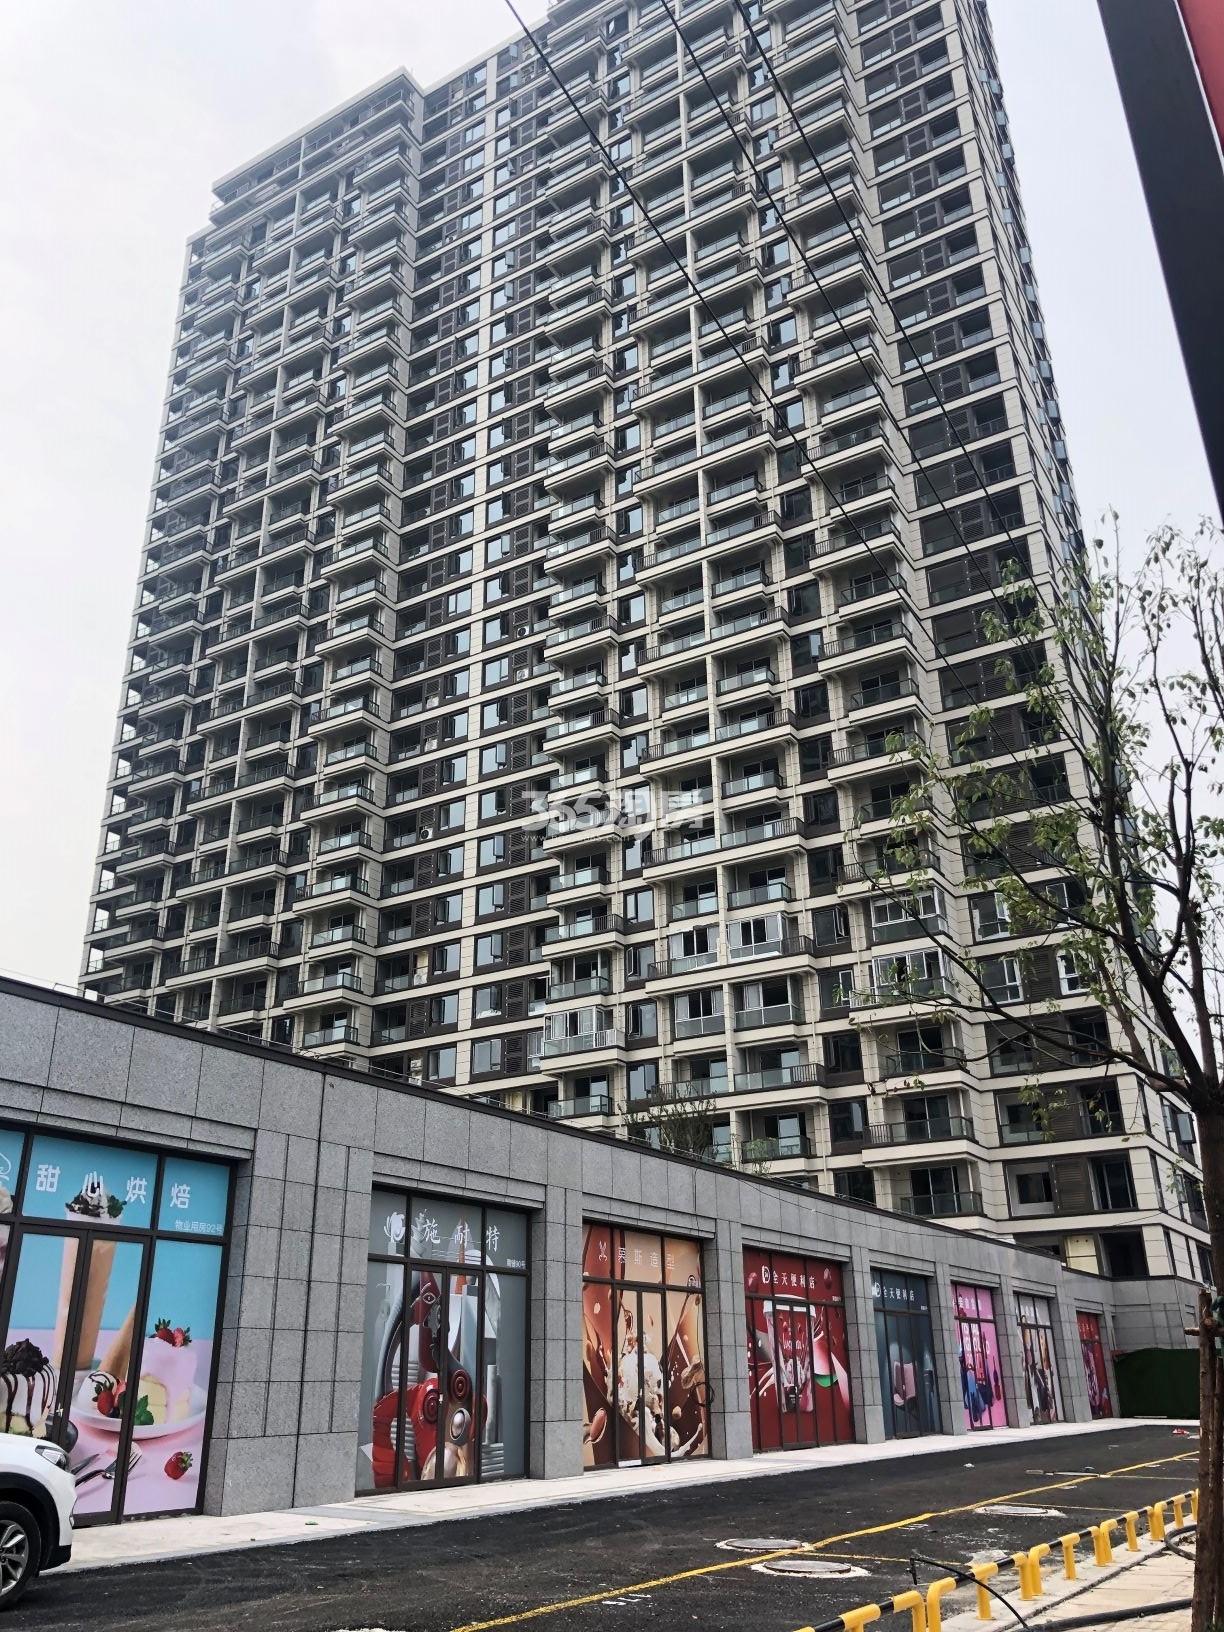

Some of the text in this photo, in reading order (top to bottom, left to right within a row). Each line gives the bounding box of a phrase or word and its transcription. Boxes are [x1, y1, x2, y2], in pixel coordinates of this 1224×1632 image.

[36, 1164, 191, 1209] 甜心烘焙
[773, 1270, 816, 1289] 全天便利店
